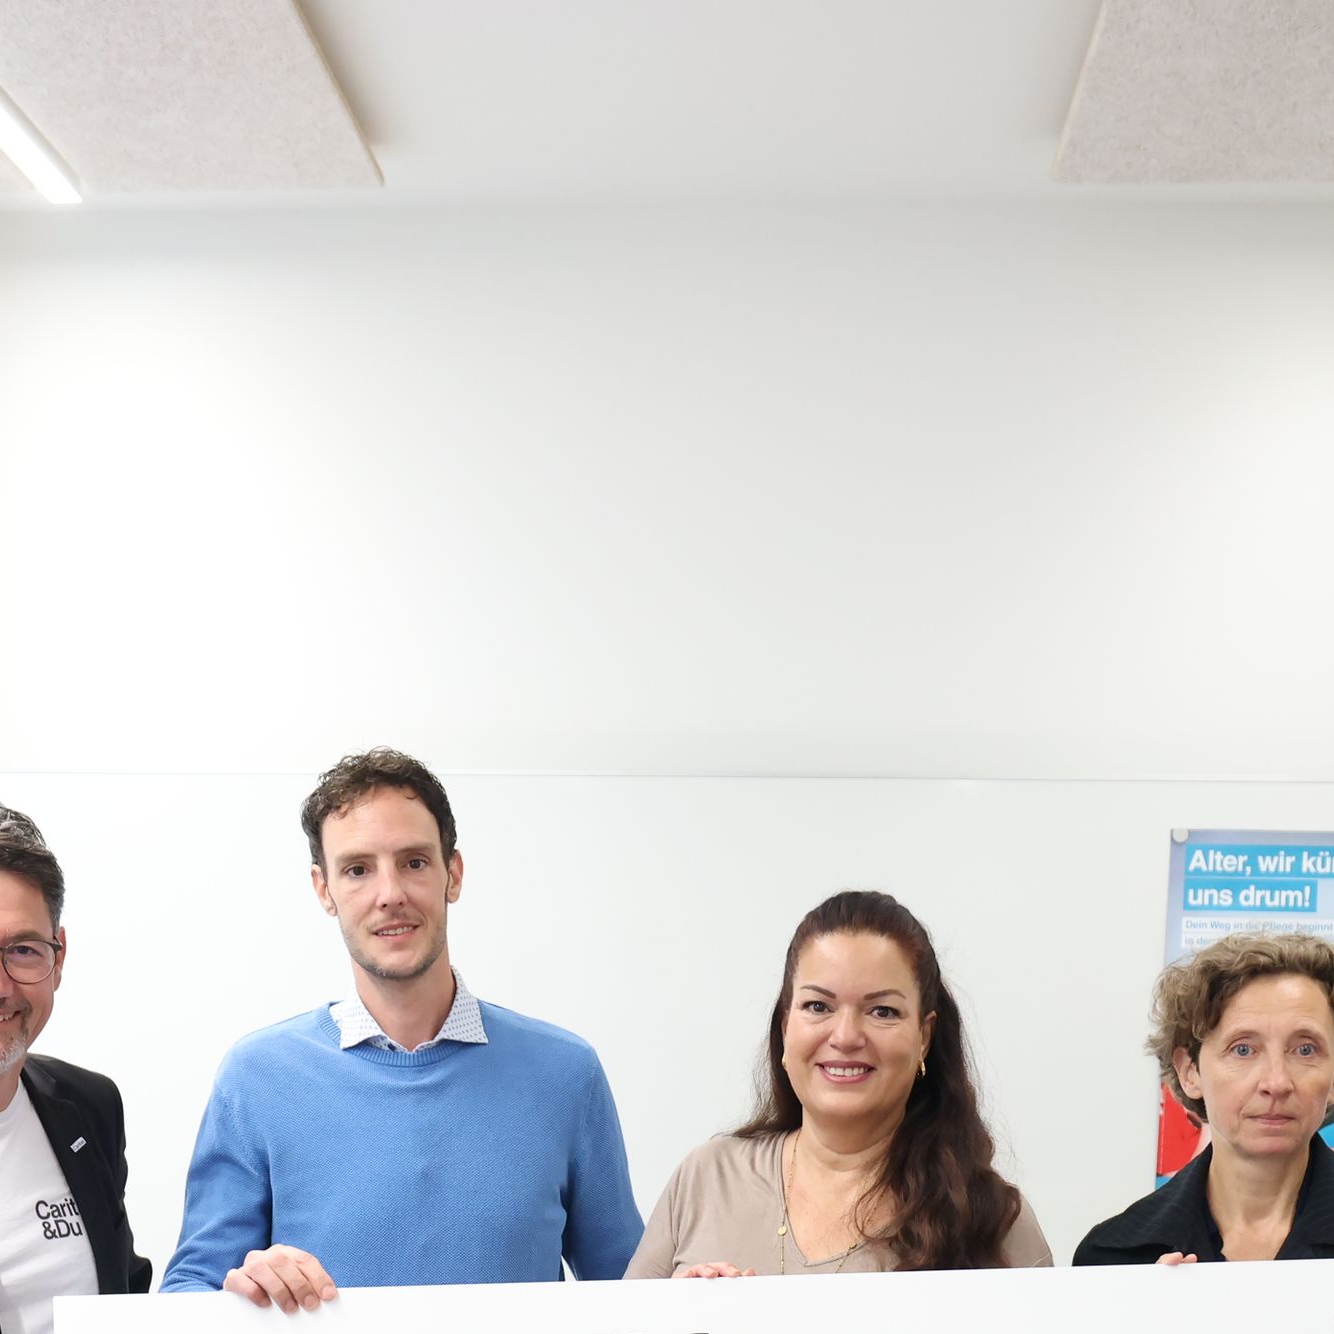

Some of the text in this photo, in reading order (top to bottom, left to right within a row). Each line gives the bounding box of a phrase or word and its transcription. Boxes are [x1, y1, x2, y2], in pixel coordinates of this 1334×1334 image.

[1188, 849, 1251, 876] Alter,
[1258, 851, 1295, 873] wir
[1187, 885, 1310, 907] uns drum!
[1185, 920, 1208, 929] Dein
[1210, 920, 1230, 931] Weg
[35, 1198, 79, 1220] Carit
[42, 1219, 83, 1240] &Du
